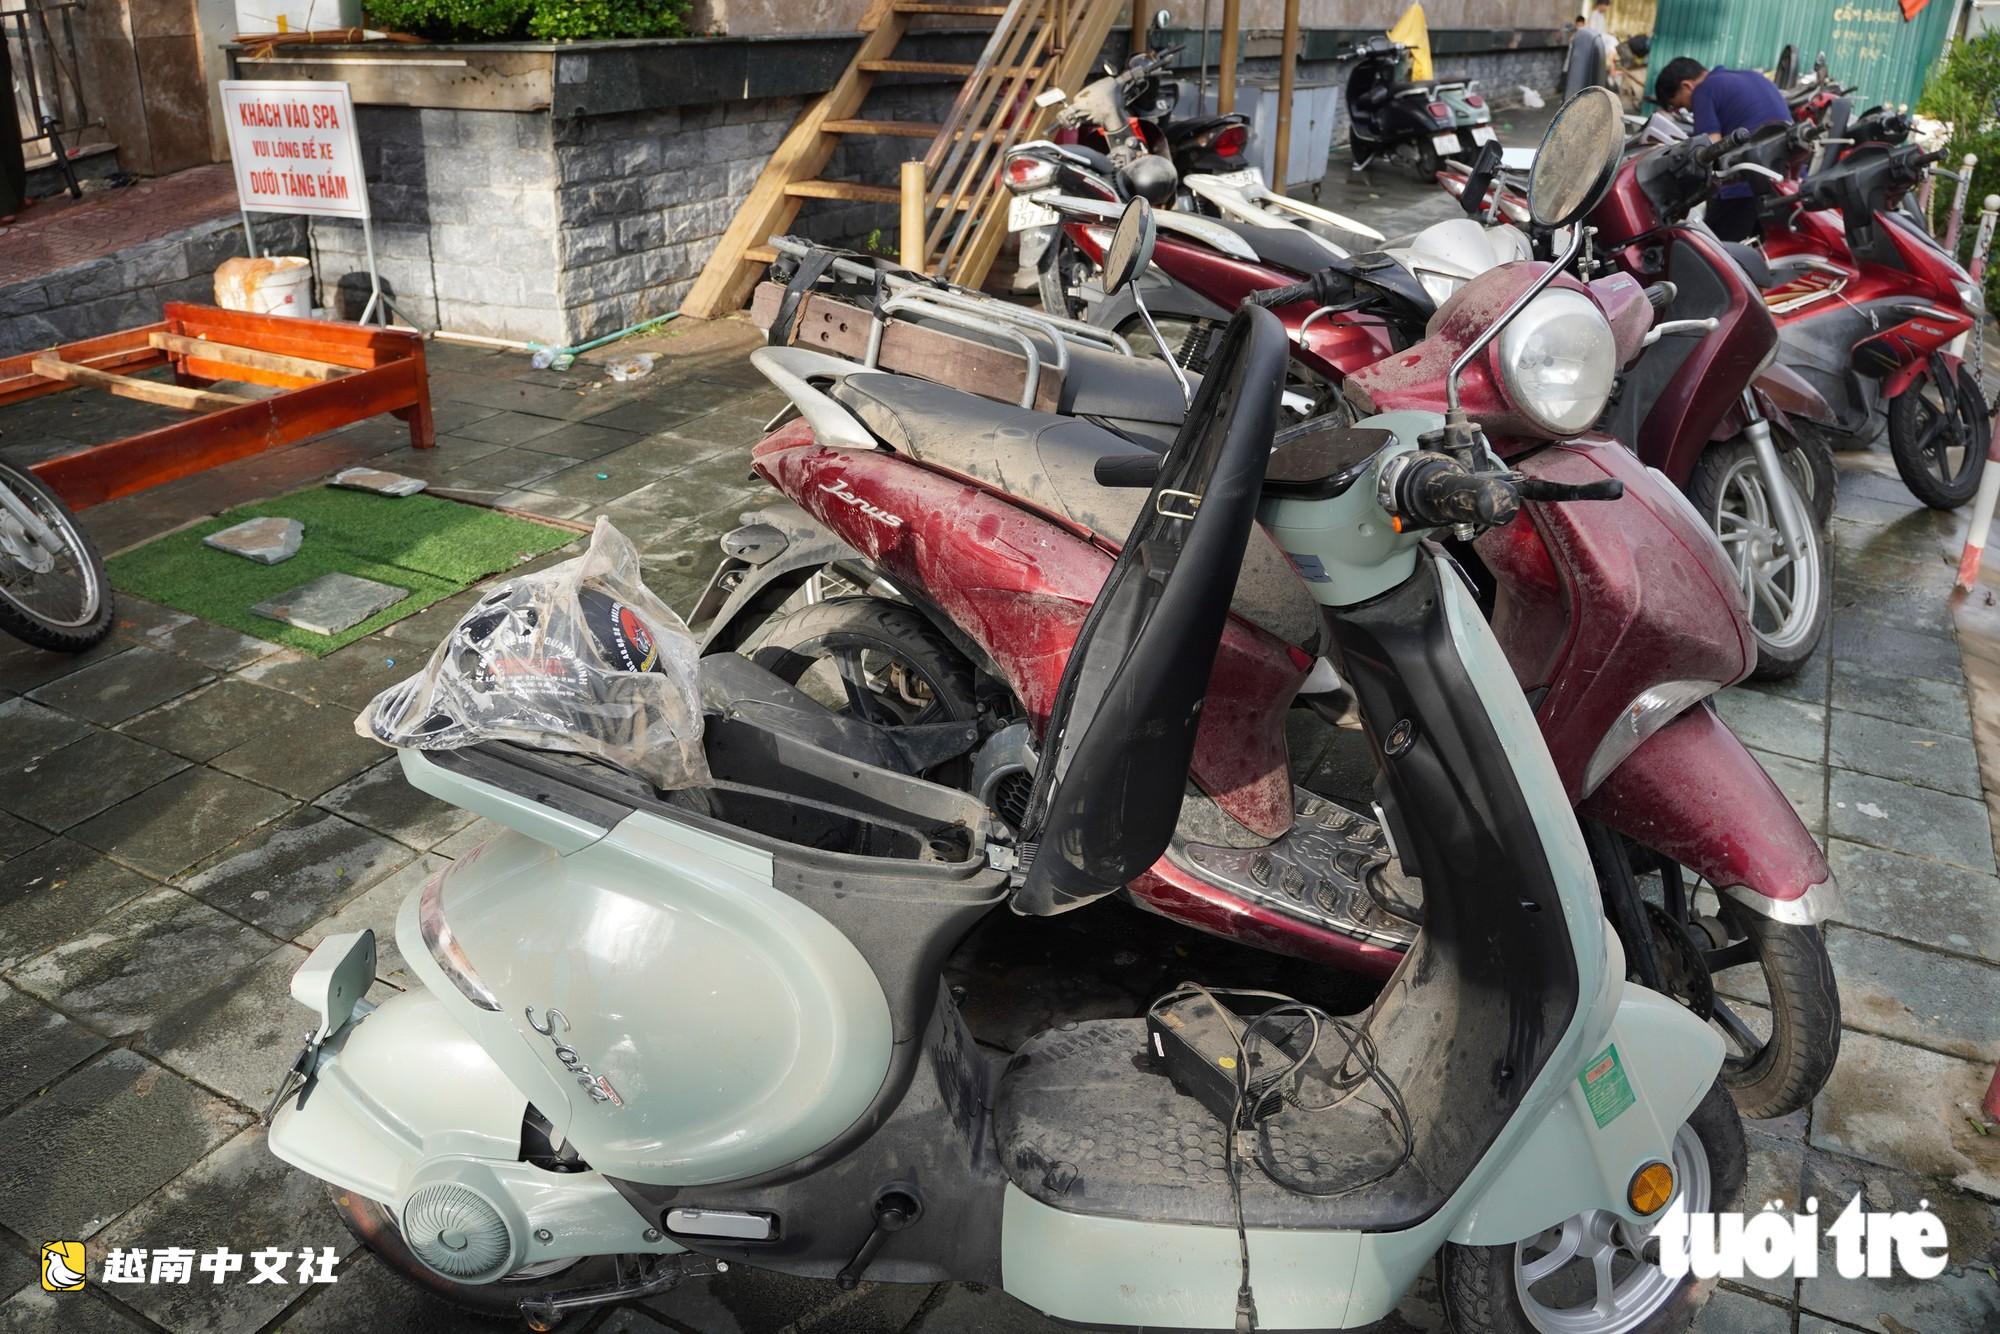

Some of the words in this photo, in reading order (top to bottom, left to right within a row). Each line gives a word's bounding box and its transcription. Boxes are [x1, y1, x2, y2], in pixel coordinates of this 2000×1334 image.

[239, 98, 283, 127] KHÁCH
[283, 98, 310, 129] VÀO
[313, 104, 340, 129] SPA
[252, 140, 270, 157] VUI
[273, 137, 300, 159] LÒNG
[302, 136, 317, 160] ĐỂ
[319, 143, 334, 160] XE
[250, 167, 281, 195] DƯỚI
[281, 165, 316, 198] TẦNG
[318, 167, 349, 199] HẦM
[545, 636, 576, 658] QUANG
